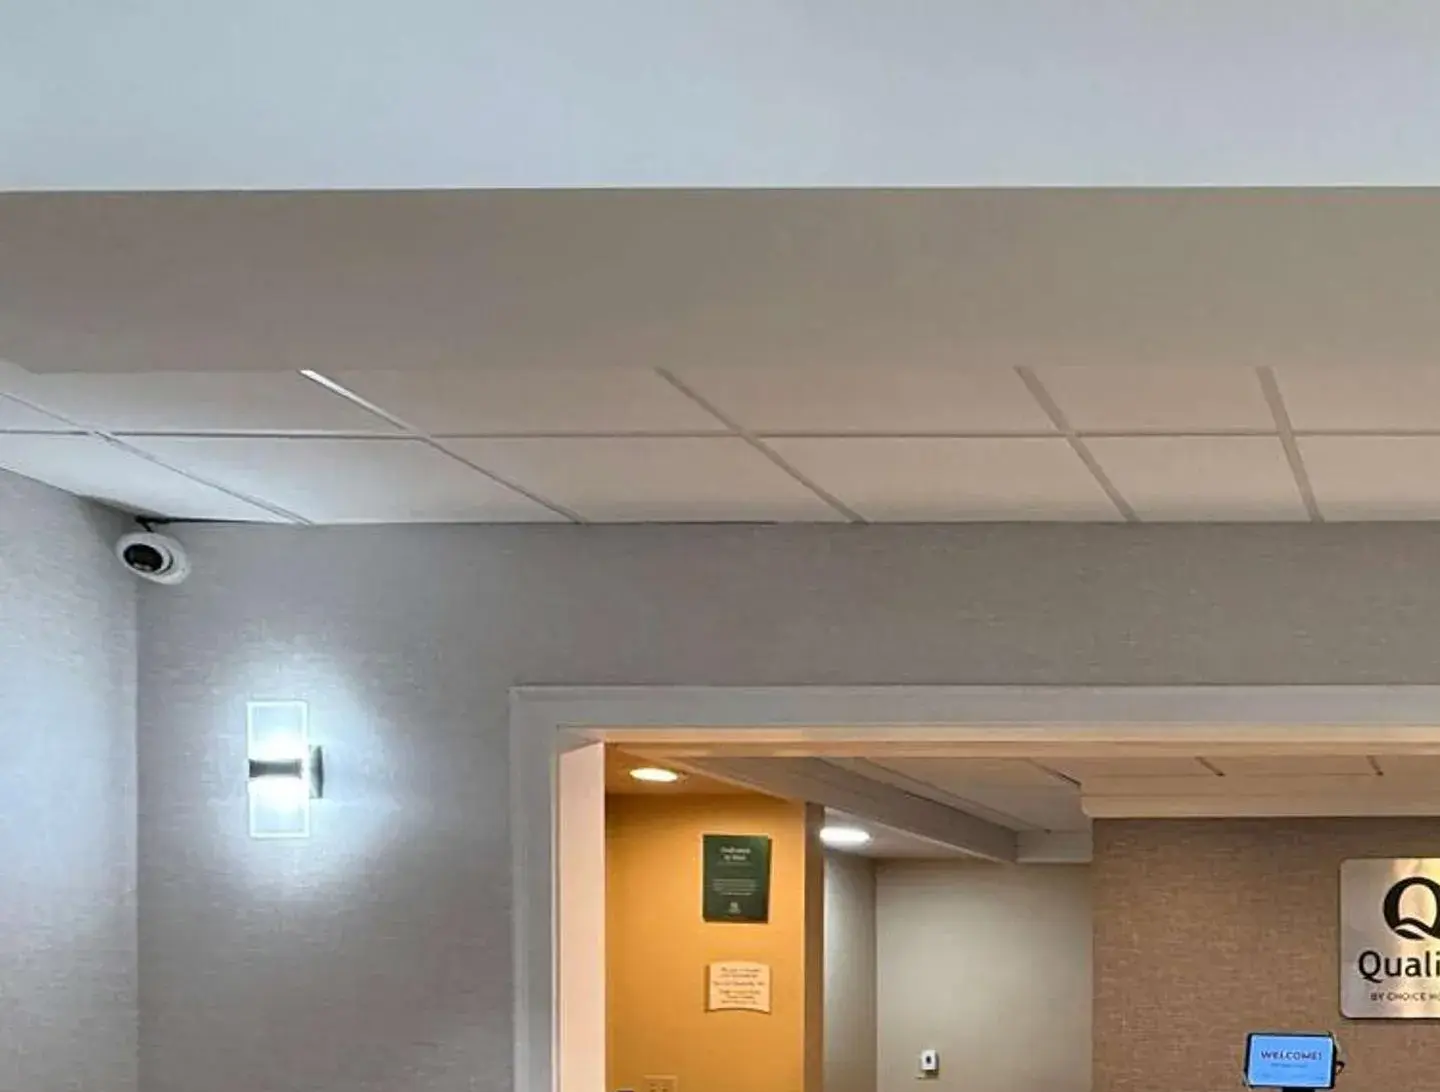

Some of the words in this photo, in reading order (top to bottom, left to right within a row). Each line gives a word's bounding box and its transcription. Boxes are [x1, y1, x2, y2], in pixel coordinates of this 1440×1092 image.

[1370, 992, 1385, 1002] BY
[1386, 992, 1427, 1002] CHOICE
[1260, 1050, 1322, 1061] WELCOME!
